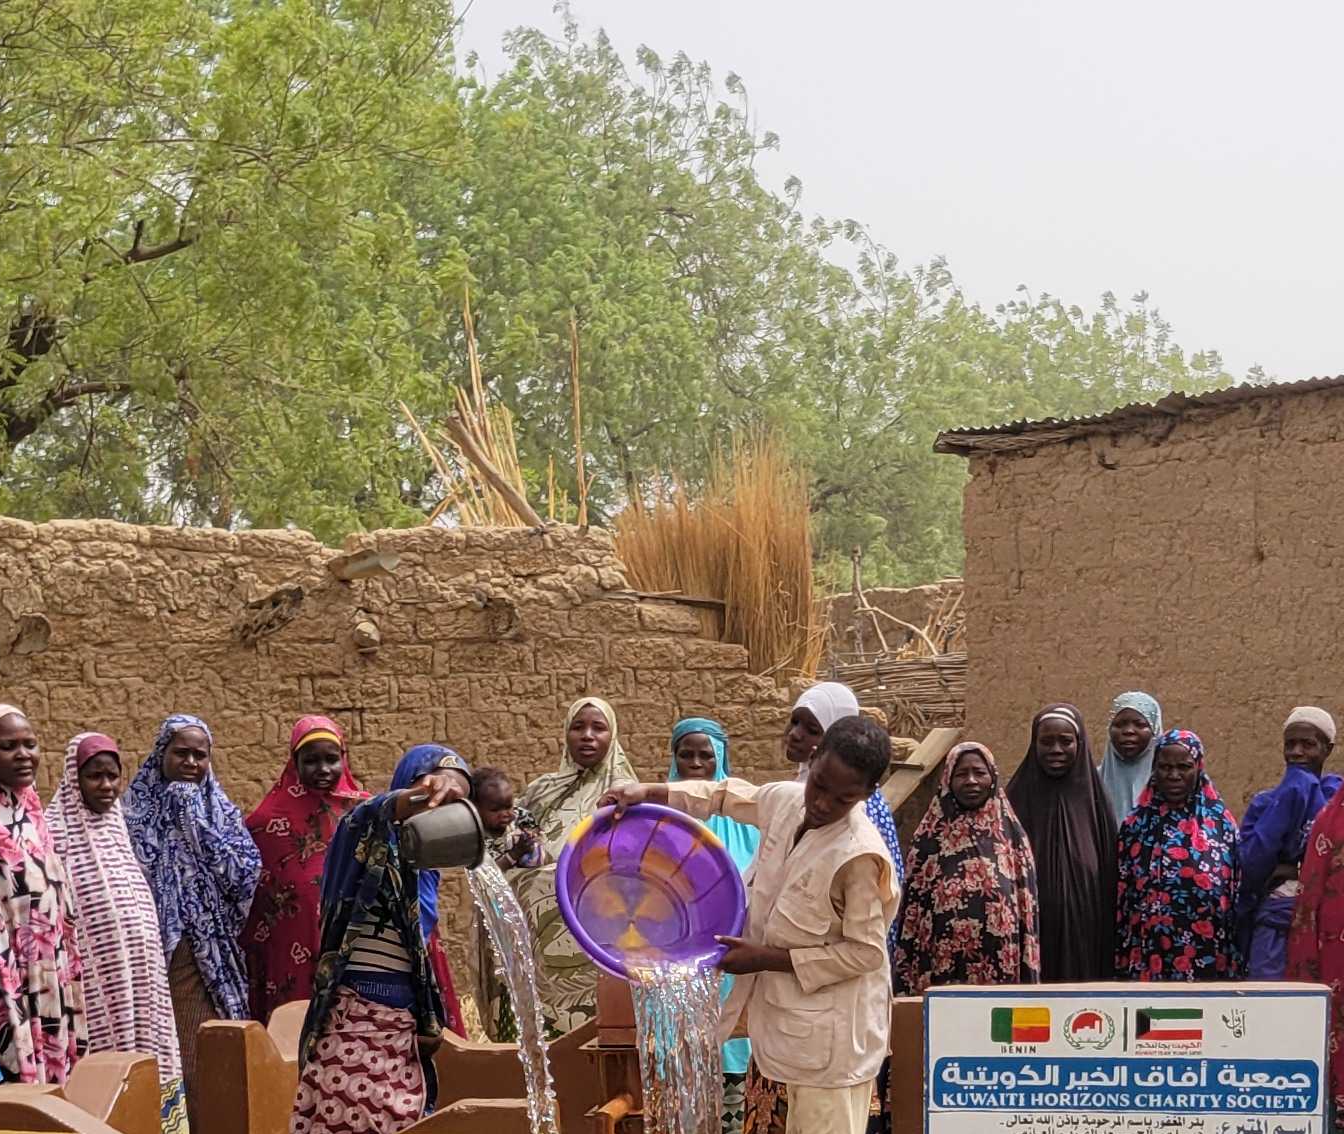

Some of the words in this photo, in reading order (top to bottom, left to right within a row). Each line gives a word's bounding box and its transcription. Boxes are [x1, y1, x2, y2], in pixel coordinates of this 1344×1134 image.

[1000, 1045, 1037, 1054] BENIN
[941, 1061, 1060, 1090] الكويتية
[1065, 1065, 1128, 1091] الخير
[1217, 1064, 1312, 1093] جمعية
[941, 1092, 1026, 1107] KUWAITI
[1030, 1092, 1131, 1108] HORIZONS
[1133, 1093, 1224, 1109] CHARITY
[1226, 1095, 1312, 1110] SOCIETY
[1035, 1114, 1055, 1126] الله
